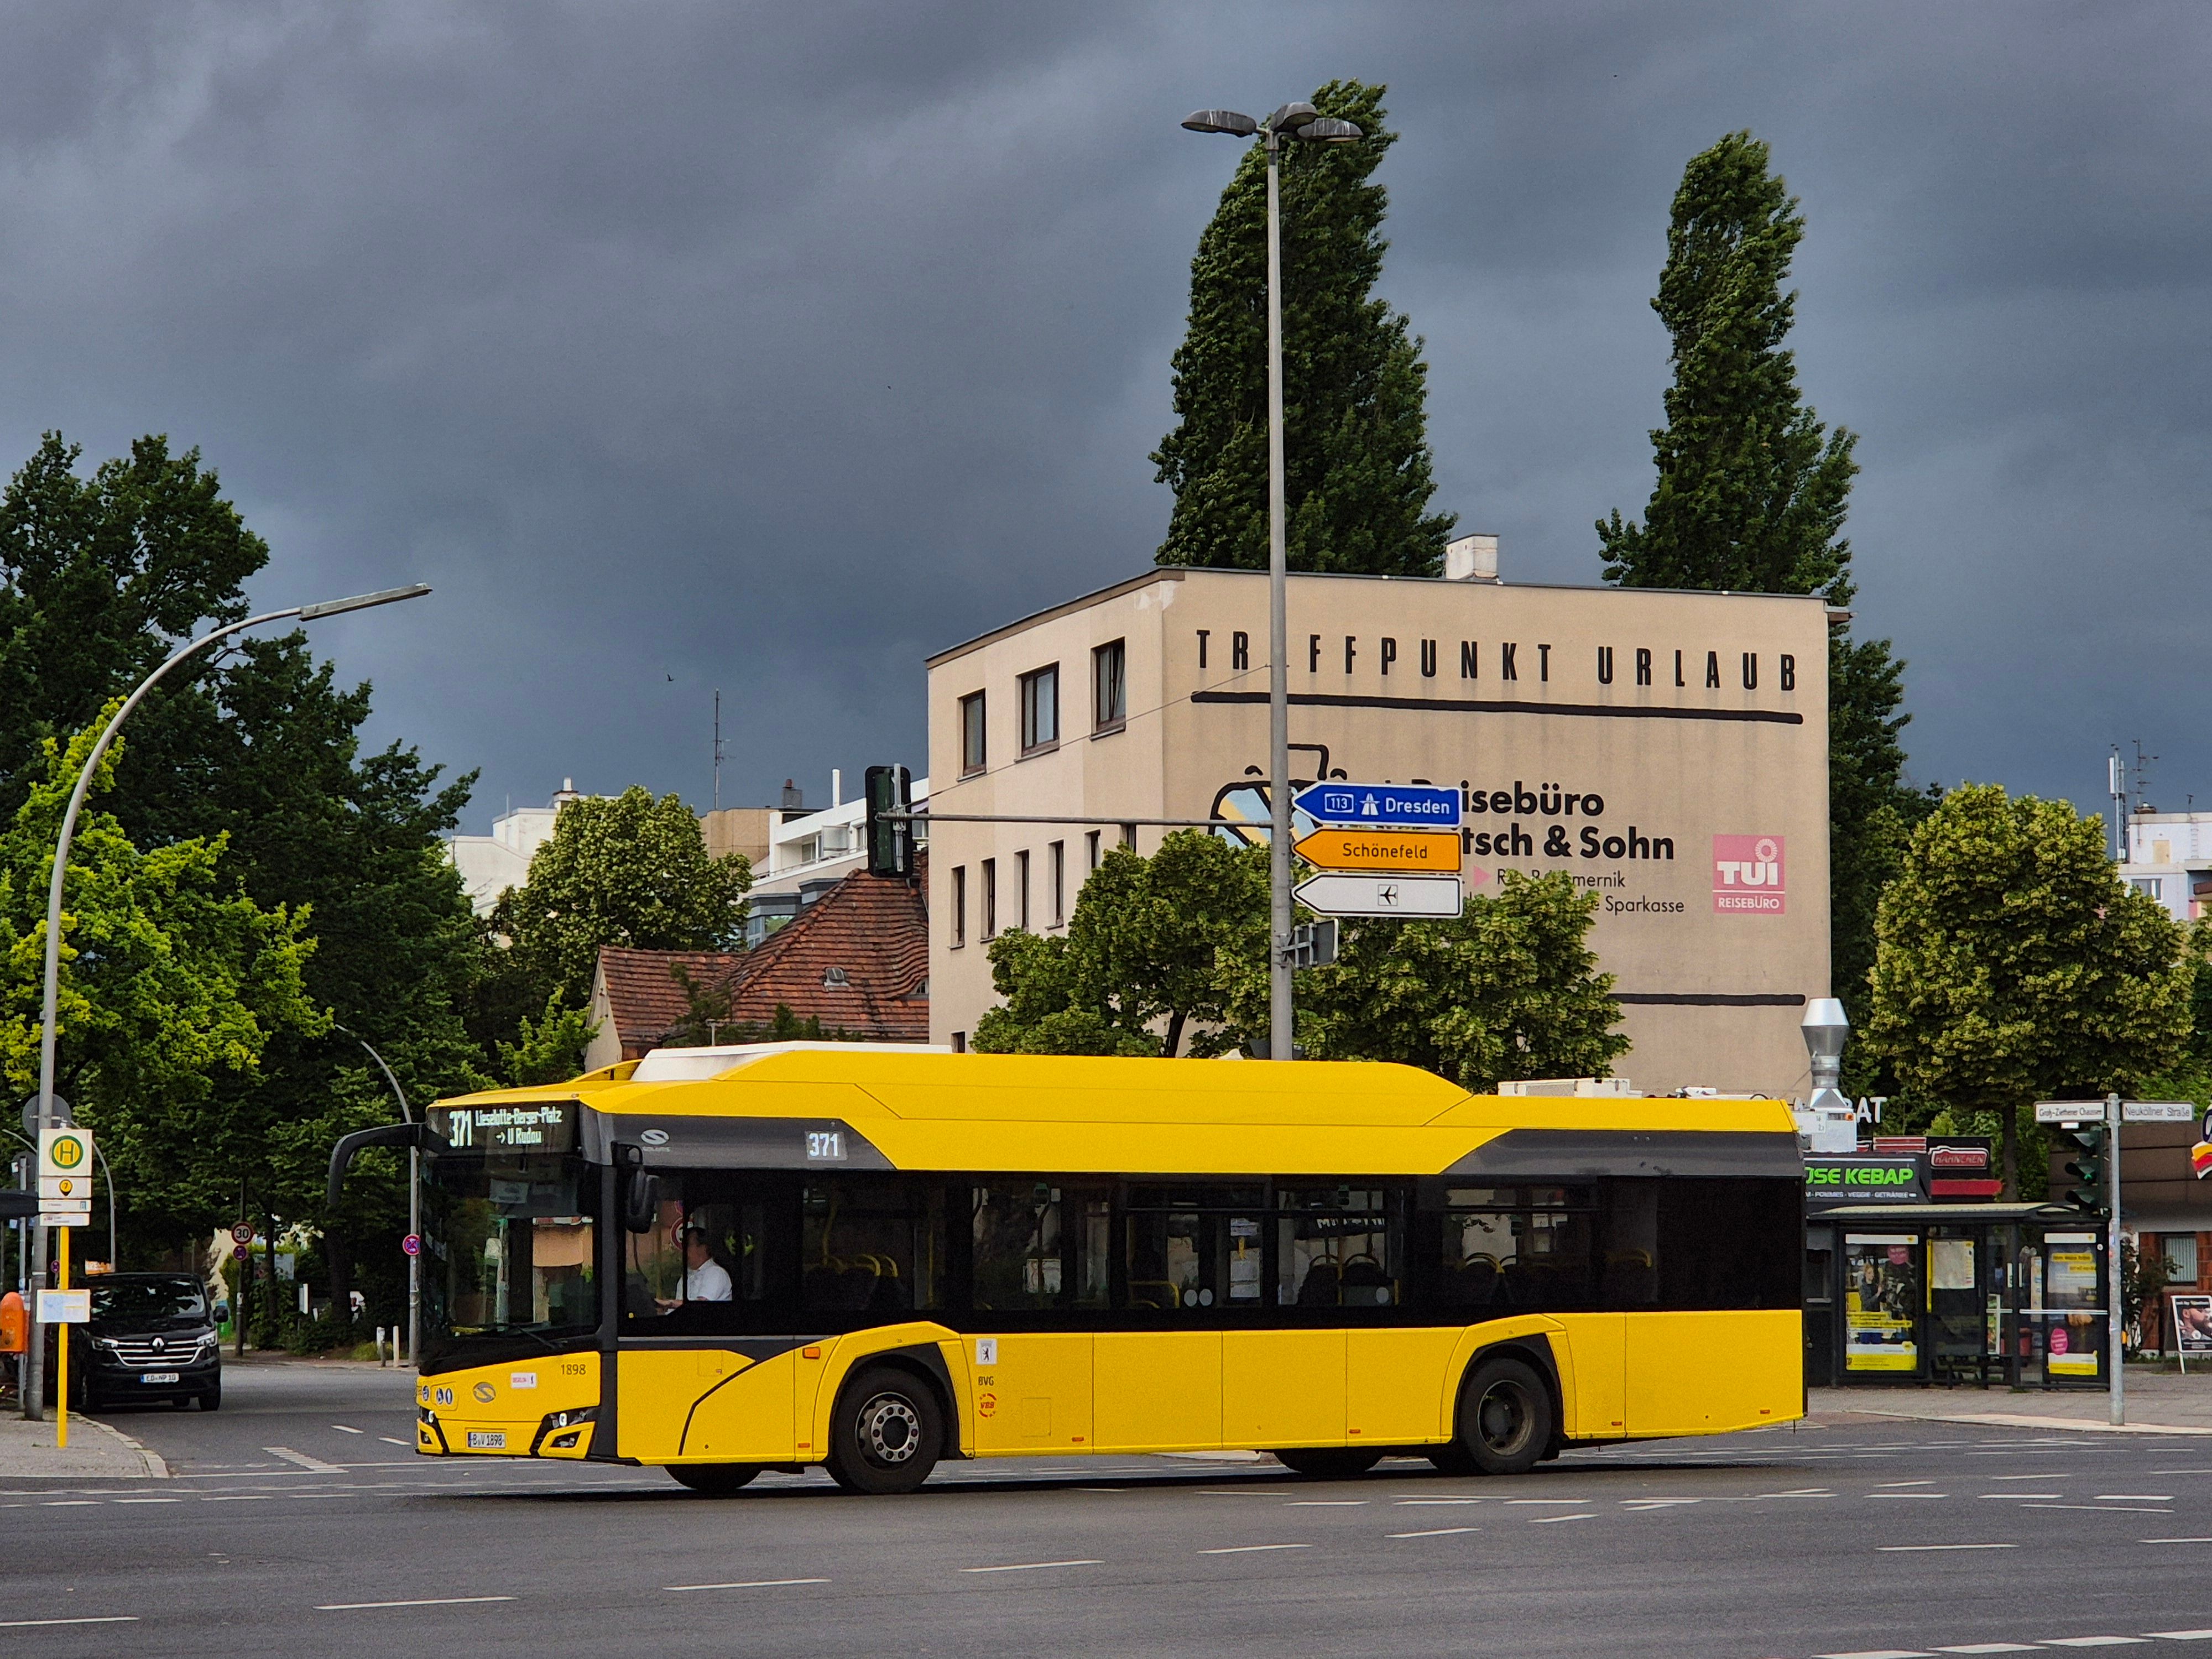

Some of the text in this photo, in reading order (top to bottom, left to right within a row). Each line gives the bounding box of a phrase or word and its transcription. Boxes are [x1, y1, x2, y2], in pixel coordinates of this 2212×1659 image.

[1196, 629, 1795, 691] TRFFPUNKT URLAUB
[1331, 797, 1450, 814] 113 Dresden
[1411, 779, 1604, 816] isebüro
[1451, 822, 1674, 860] tsch & Sohn
[1342, 843, 1427, 859] Schönefeld
[1717, 838, 1778, 885] TUI
[1605, 895, 1684, 916] Sparkasse
[1718, 896, 1780, 909] REISEBÜRO
[2125, 1106, 2190, 1117] Neuköllner Straße
[449, 1106, 563, 1147] 371 Lieselotte-Berger-Platz
[507, 1127, 543, 1145] U Rudow
[808, 1133, 839, 1157] 371
[60, 1142, 74, 1162] H
[1845, 1167, 1914, 1185] KEBAP
[236, 1228, 249, 1239] 30
[560, 1364, 586, 1375] 1898
[978, 1376, 994, 1386] BVG
[487, 1434, 503, 1446] 1898
